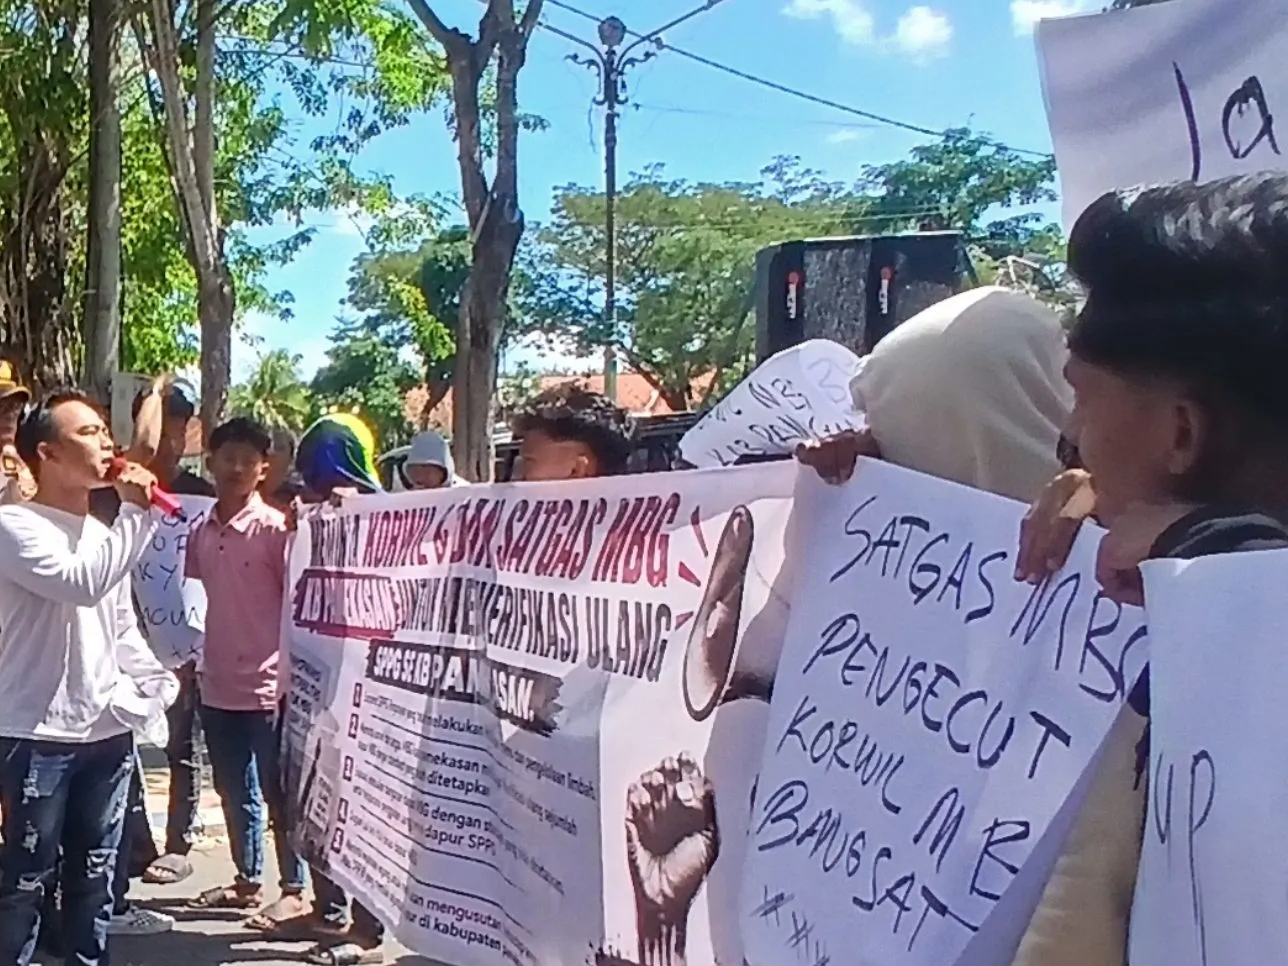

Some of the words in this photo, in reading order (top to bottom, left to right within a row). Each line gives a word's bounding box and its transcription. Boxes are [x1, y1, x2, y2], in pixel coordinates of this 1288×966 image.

[497, 498, 607, 580] SATGAS
[592, 492, 681, 588] MBG
[829, 496, 1009, 622] SATGAS
[585, 596, 672, 682] ULANG
[802, 612, 1071, 779] PENGECUT
